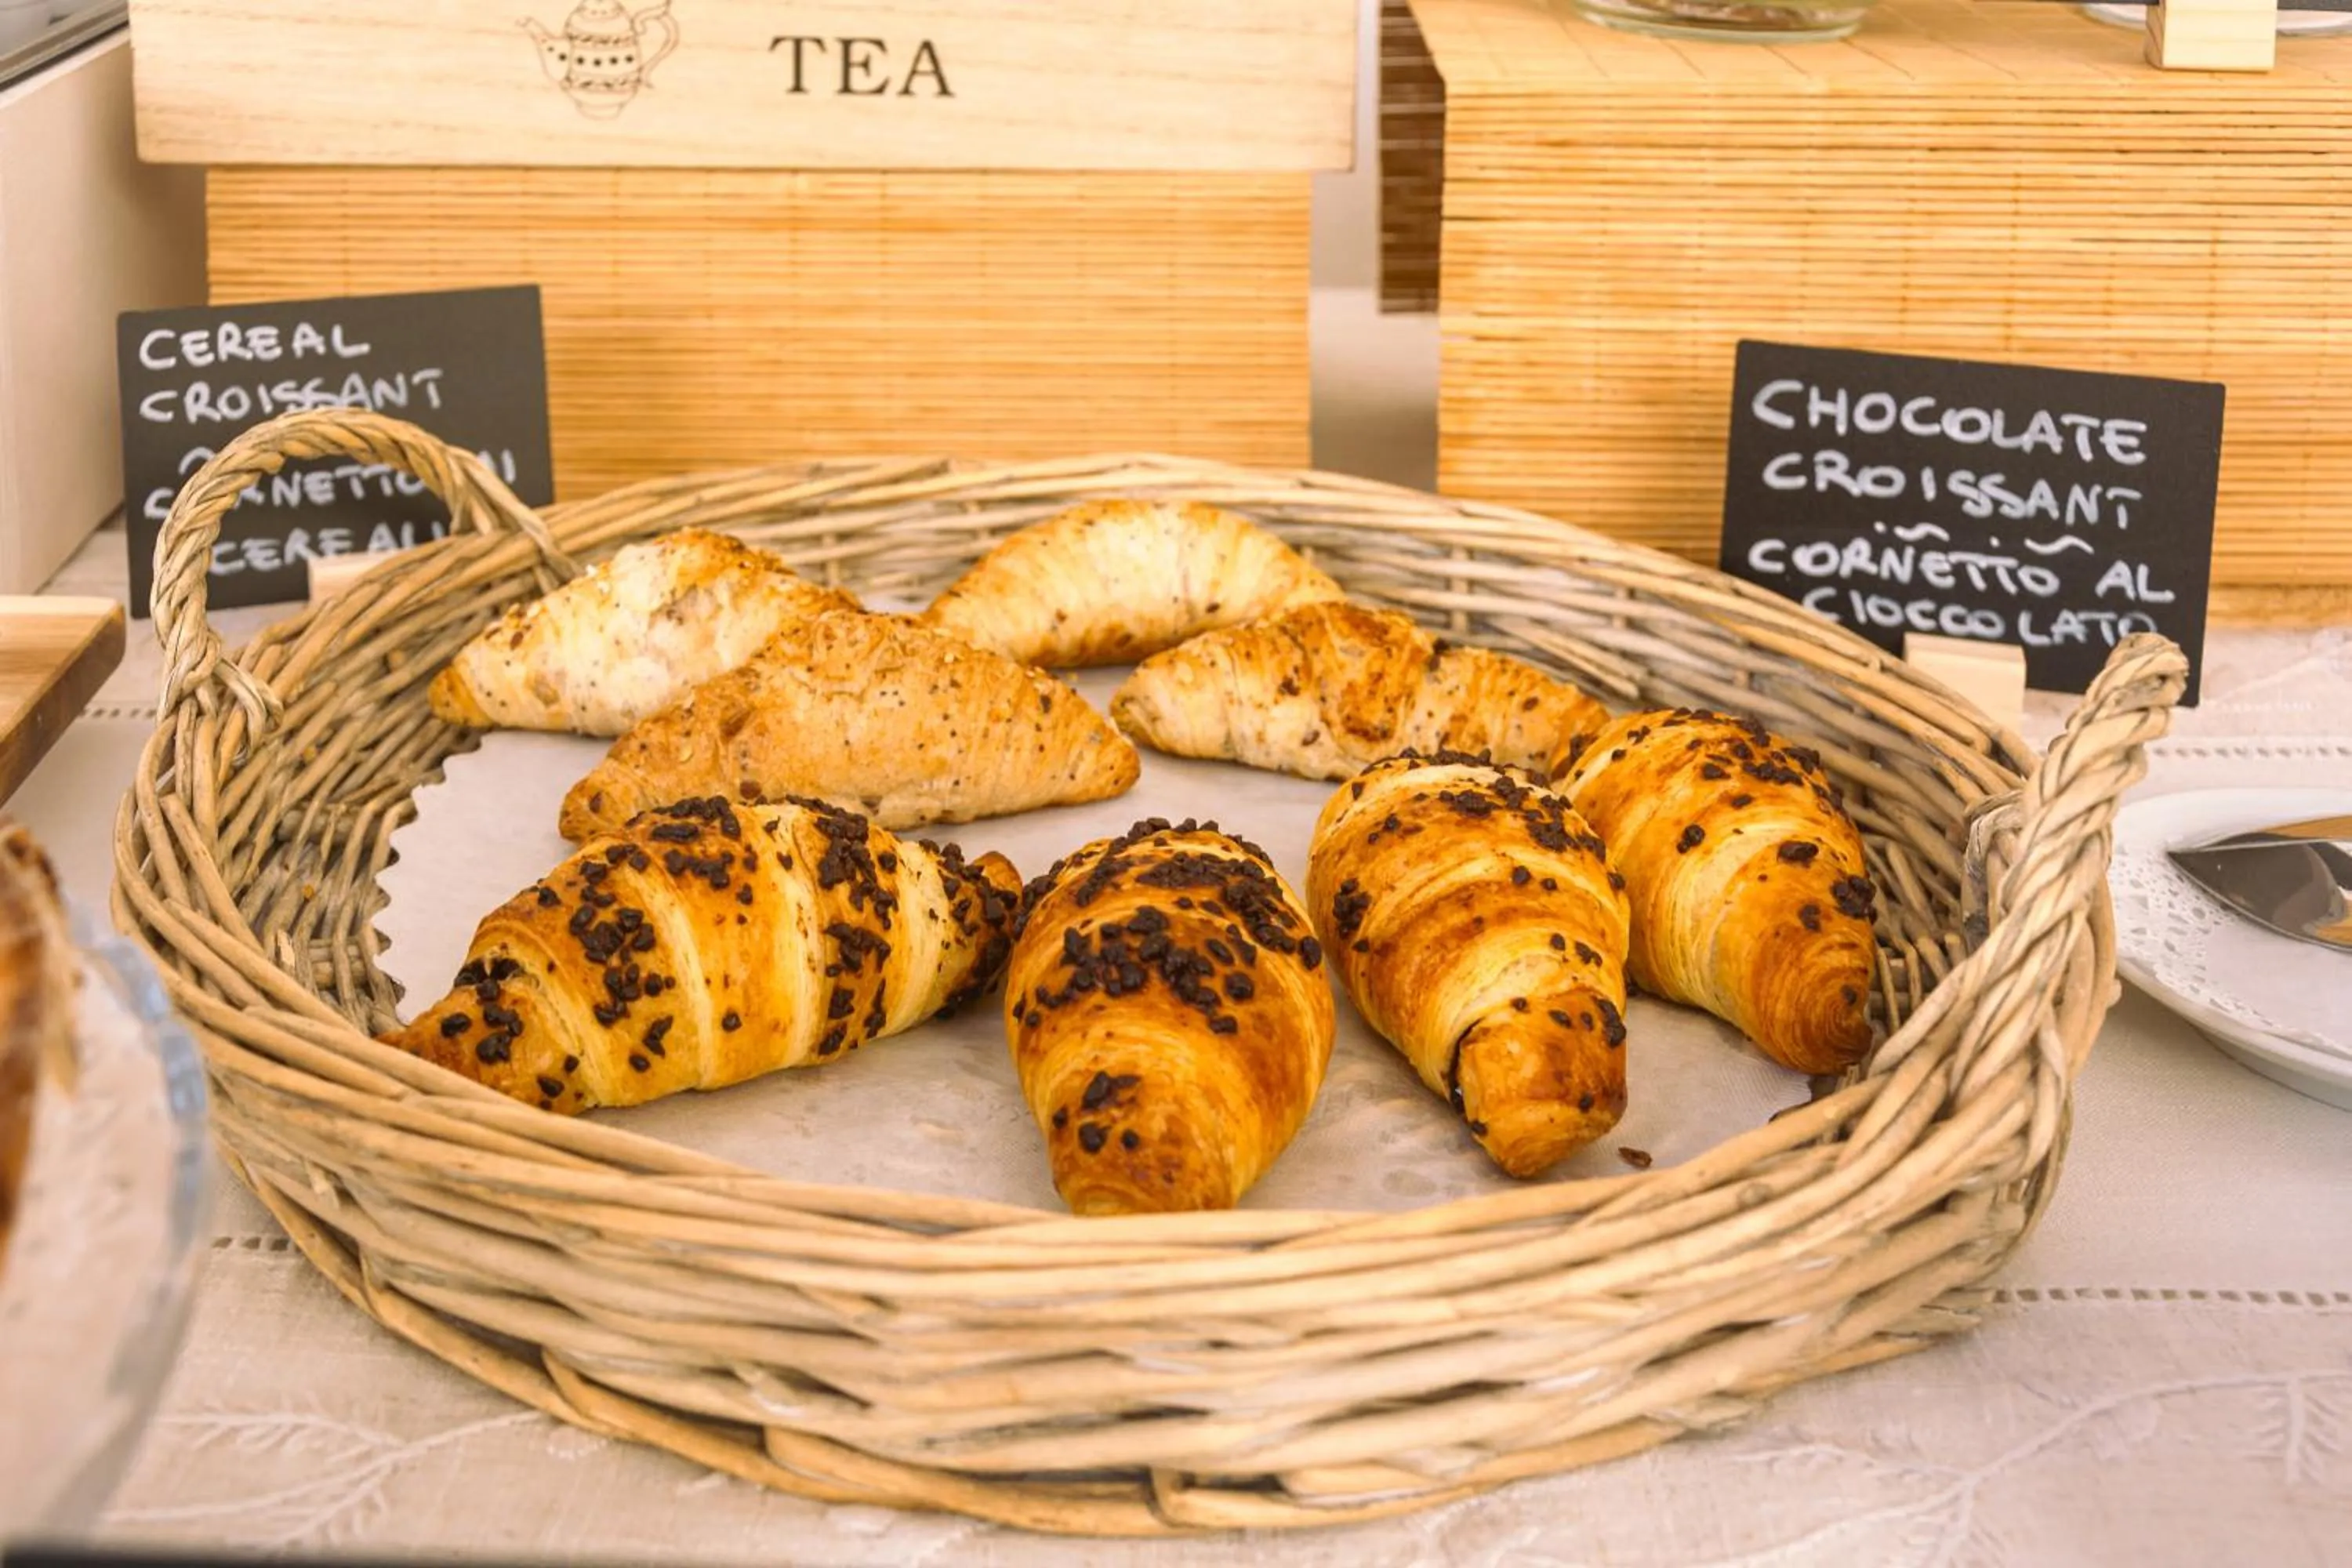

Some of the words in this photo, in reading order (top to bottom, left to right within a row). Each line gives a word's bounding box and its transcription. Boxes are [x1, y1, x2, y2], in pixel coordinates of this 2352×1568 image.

[769, 36, 955, 97] TEA
[139, 322, 370, 370] CEREAL
[140, 368, 442, 423] CROISSANT
[1751, 379, 2147, 464] CHOCOLATE
[1762, 449, 2143, 529] CROISSANT
[1748, 539, 2060, 596] CORNETTO
[2095, 560, 2175, 602] AL
[1802, 586, 2158, 648] CIOCCOLATO
